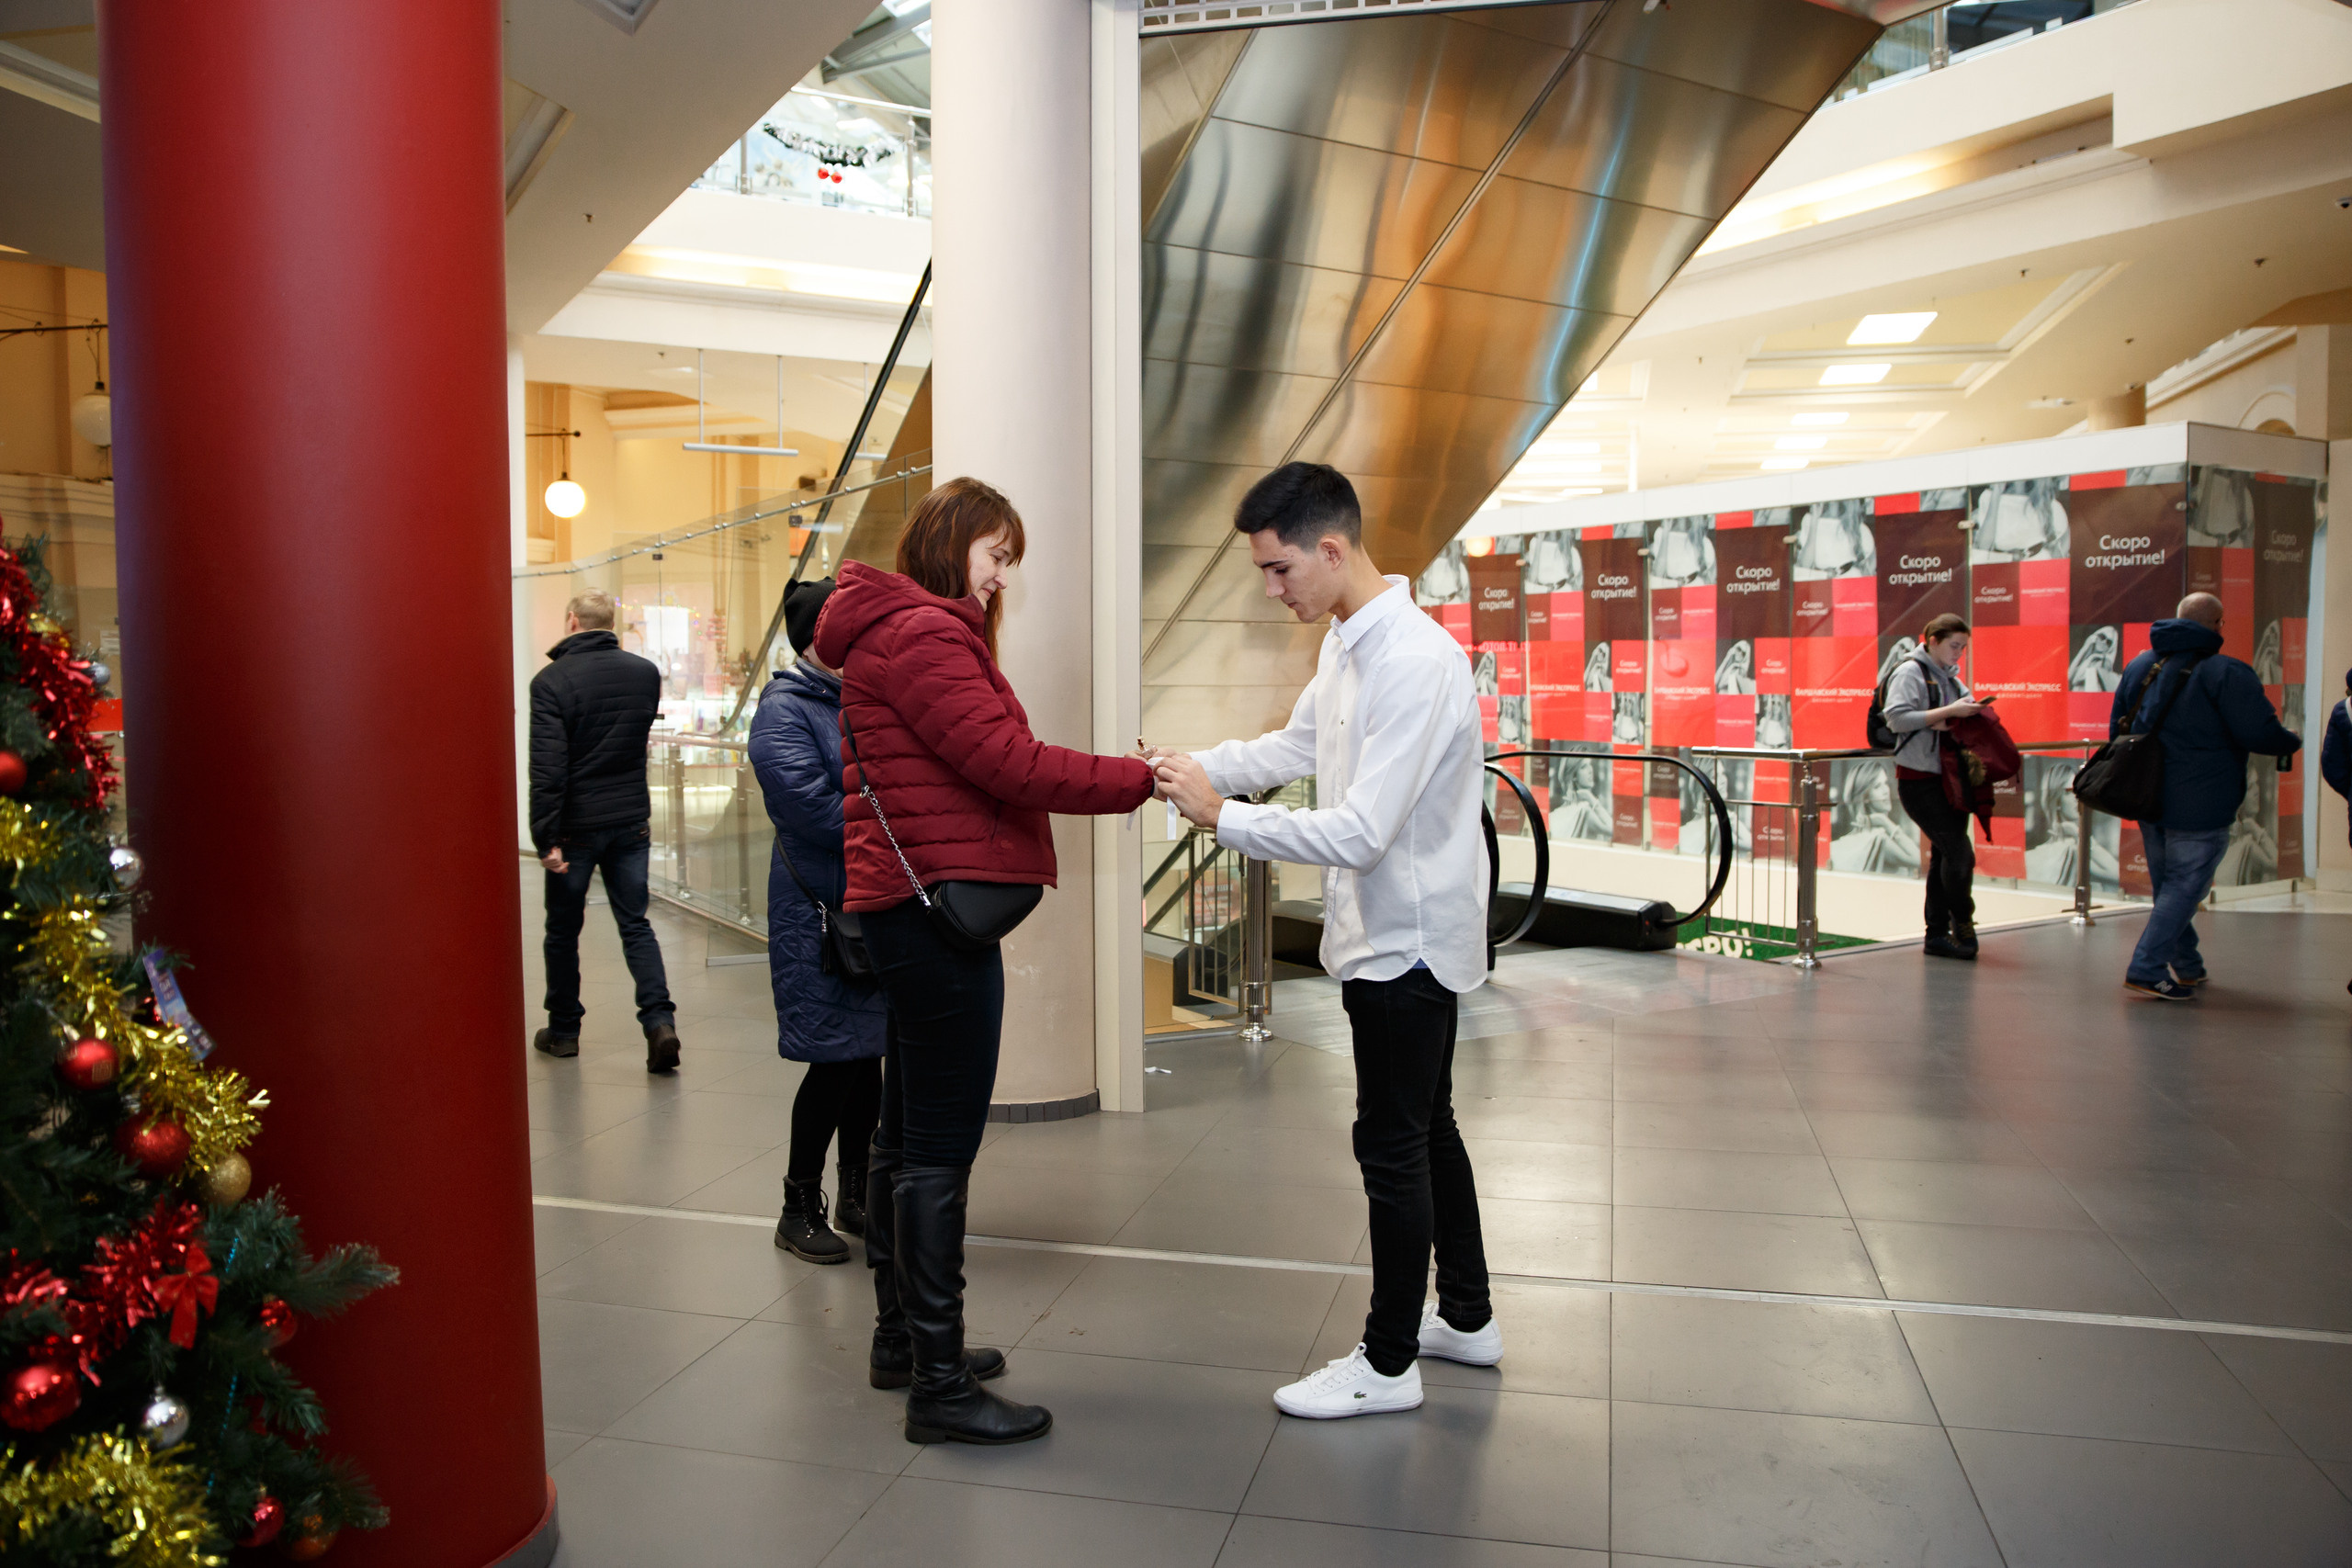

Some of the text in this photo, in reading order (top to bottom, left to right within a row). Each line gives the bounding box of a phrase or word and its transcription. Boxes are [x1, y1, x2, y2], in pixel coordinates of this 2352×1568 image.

[2099, 535, 2151, 552] Скоро
[1899, 555, 1941, 570] Скоро
[2085, 549, 2165, 570] открытие!
[1598, 574, 1629, 587] Скоро
[1736, 566, 1773, 581] Скоро
[1889, 568, 1952, 587] открытие!
[1484, 587, 1508, 600] Скоро
[1590, 586, 1637, 601] открытие!
[1726, 578, 1781, 594] открытие!
[1477, 598, 1515, 612] открытие!
